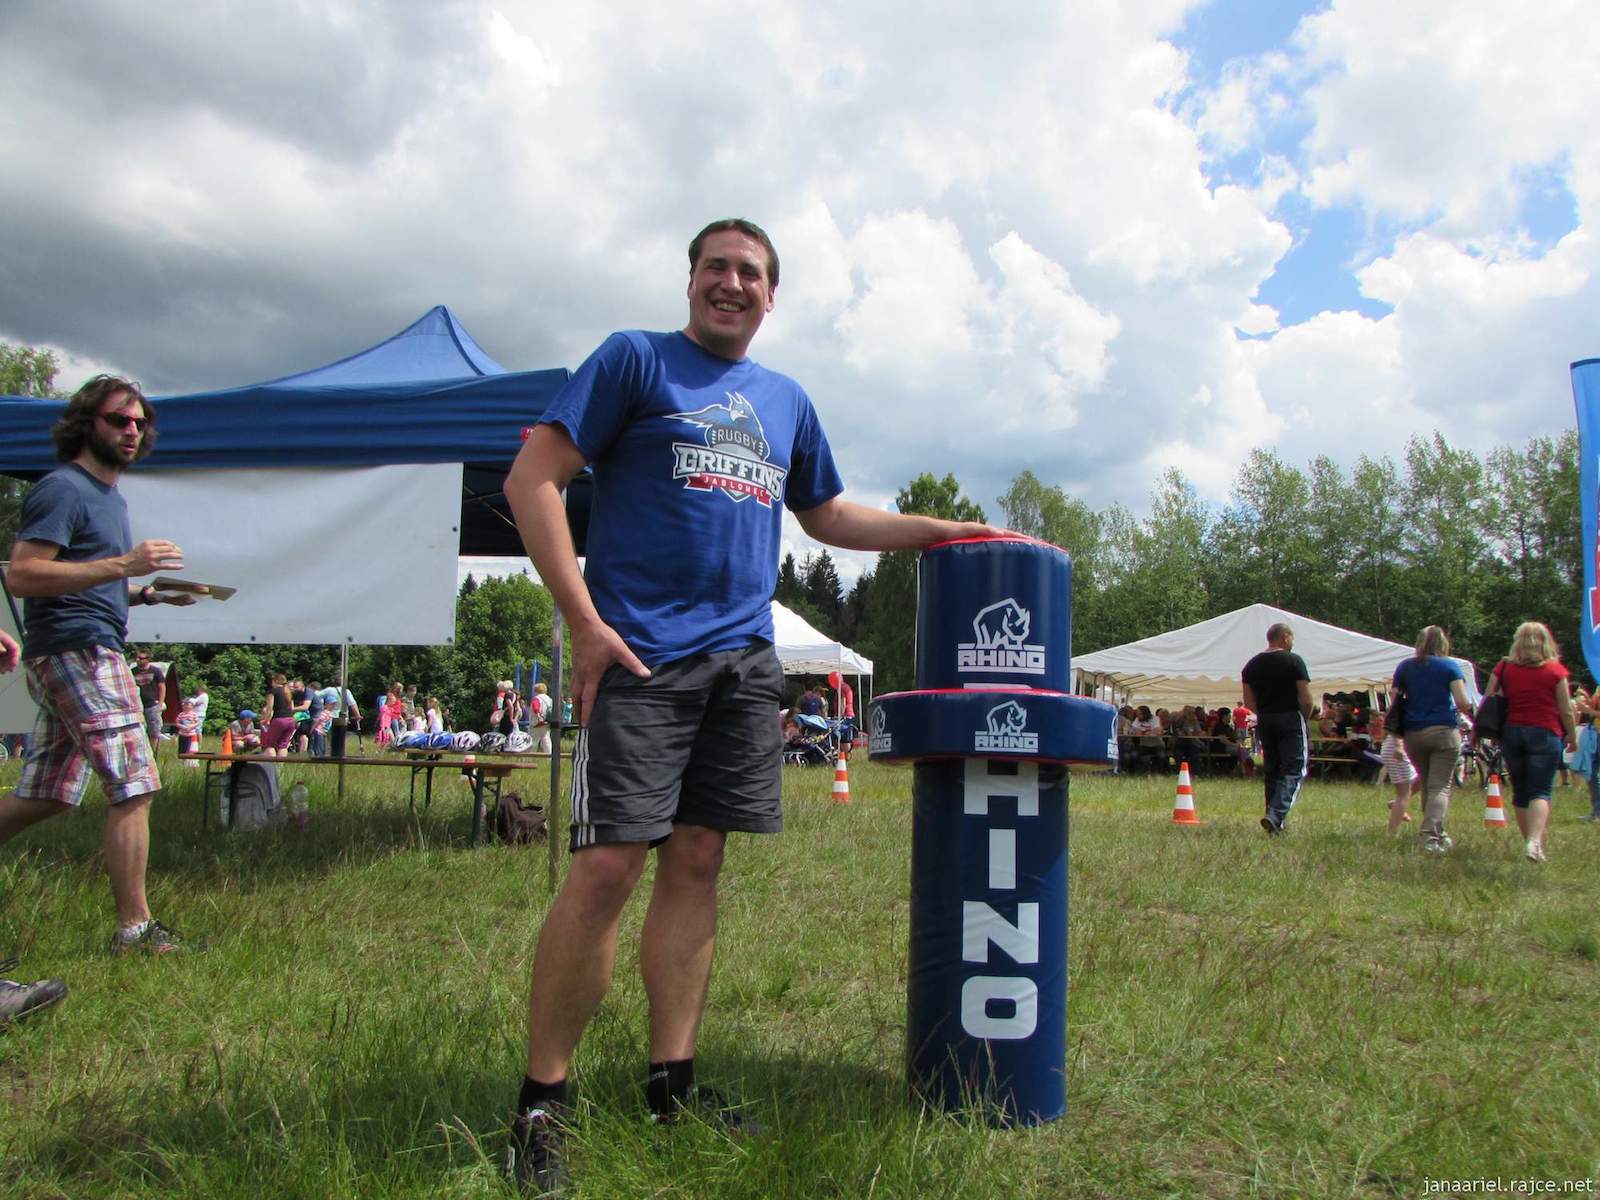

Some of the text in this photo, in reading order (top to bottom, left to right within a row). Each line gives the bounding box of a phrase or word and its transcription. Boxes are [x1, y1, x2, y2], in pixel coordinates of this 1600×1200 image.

[717, 428, 760, 450] RUGBY
[676, 448, 785, 497] GRIFFINS
[958, 650, 1045, 668] RHINO
[974, 735, 1038, 749] RHINO
[961, 683, 1039, 1039] HINO
